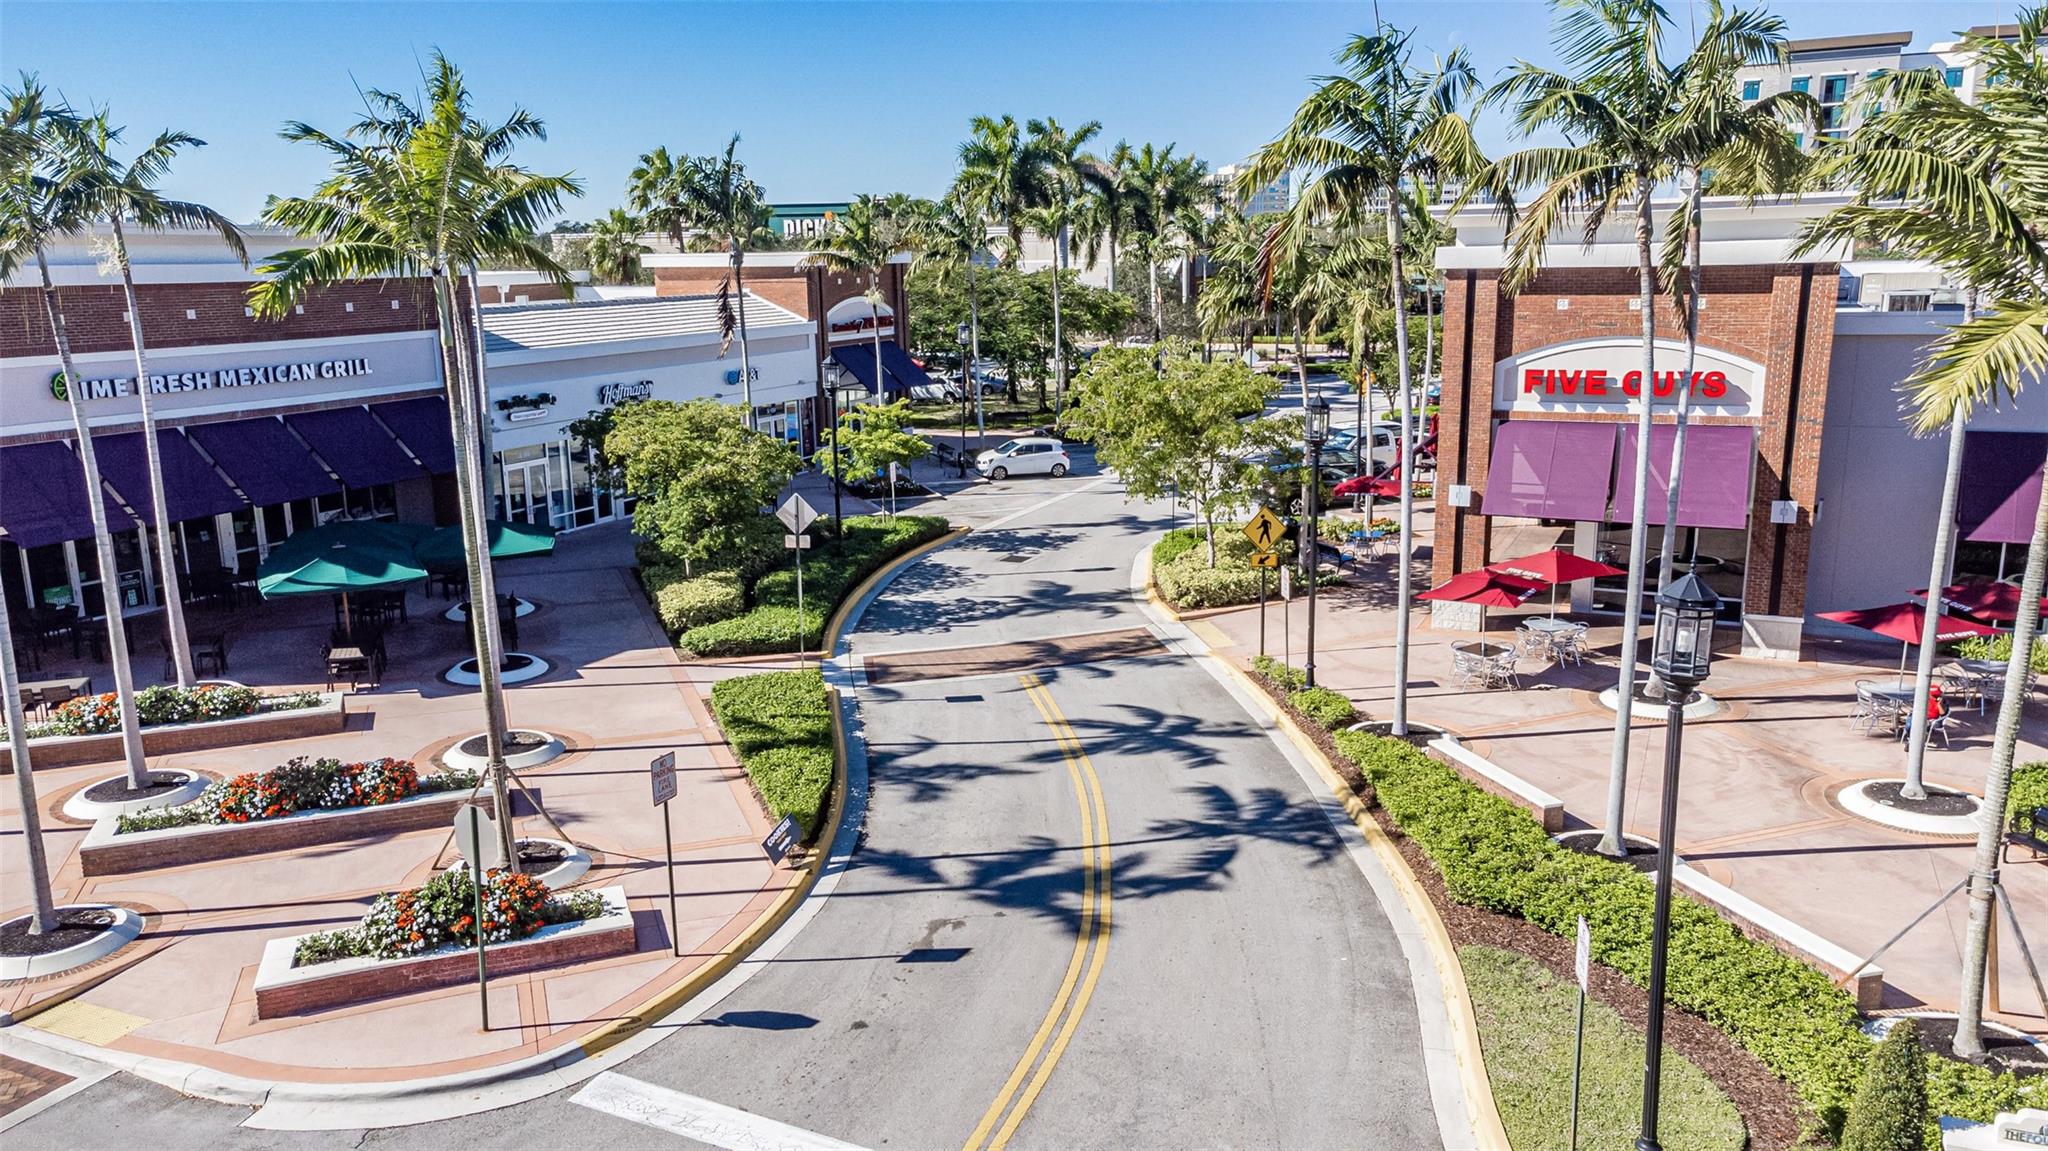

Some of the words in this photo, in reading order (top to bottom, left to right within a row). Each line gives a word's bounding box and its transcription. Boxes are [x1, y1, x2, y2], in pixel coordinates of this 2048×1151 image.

[218, 362, 317, 389] MEXICAN
[320, 358, 374, 380] GRILL
[1523, 368, 1608, 396] FIVE
[1621, 369, 1728, 398] GUYS
[601, 380, 653, 405] Hoffman's
